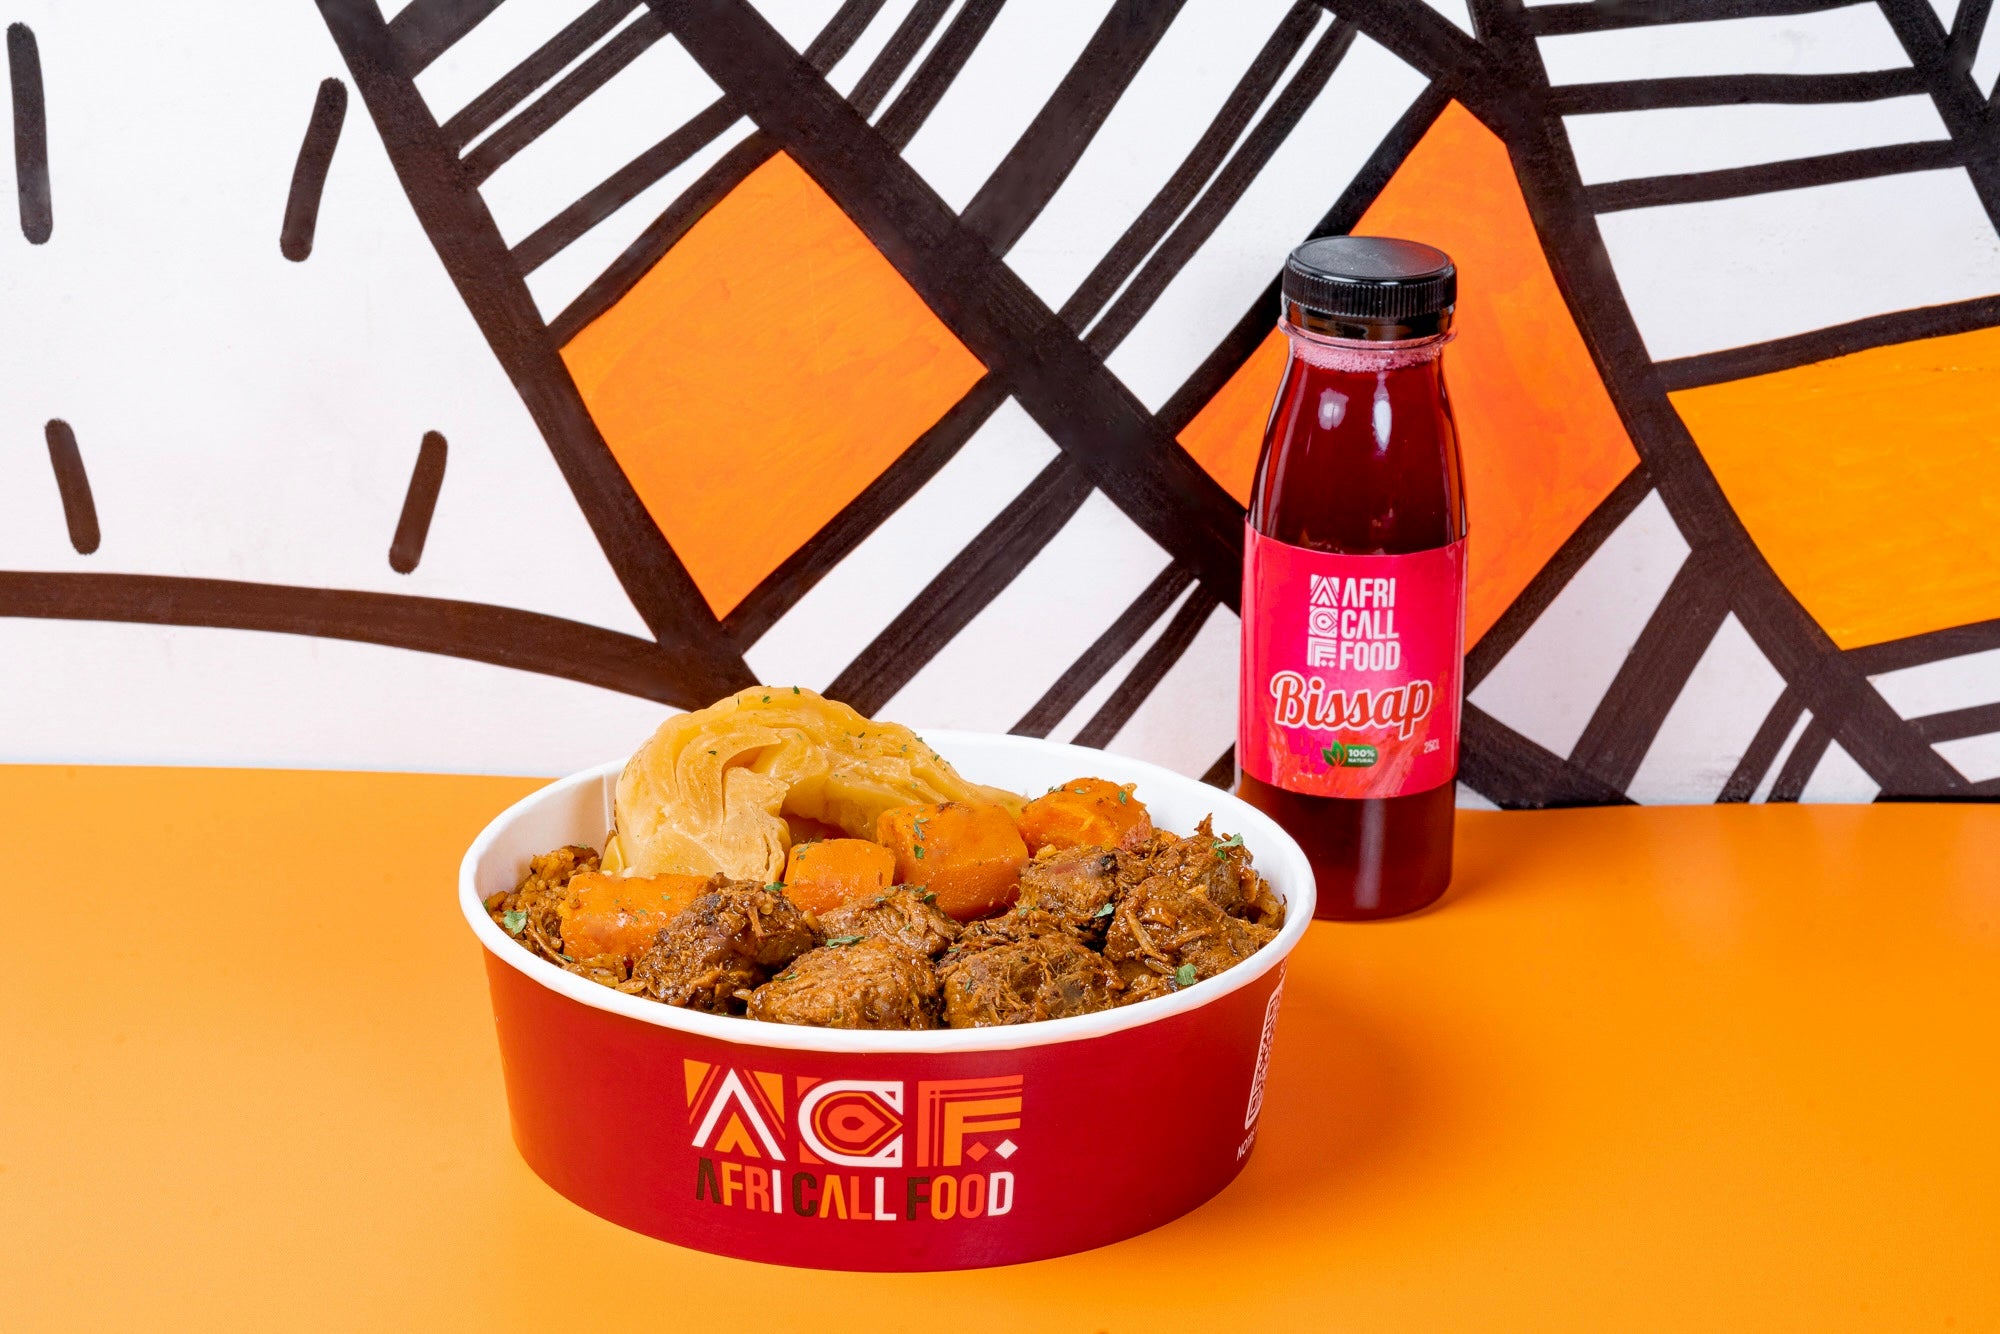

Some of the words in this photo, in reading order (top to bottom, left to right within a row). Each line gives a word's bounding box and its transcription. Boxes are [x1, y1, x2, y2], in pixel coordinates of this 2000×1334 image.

[1341, 577, 1396, 608] AFRI
[1340, 609, 1400, 640] CALL
[1339, 641, 1401, 671] FOOD
[1270, 670, 1433, 741] Bissap
[1348, 749, 1376, 758] 100%
[695, 1156, 783, 1214] AFRI
[791, 1171, 897, 1221] CALL
[906, 1170, 1015, 1221] FOOD
